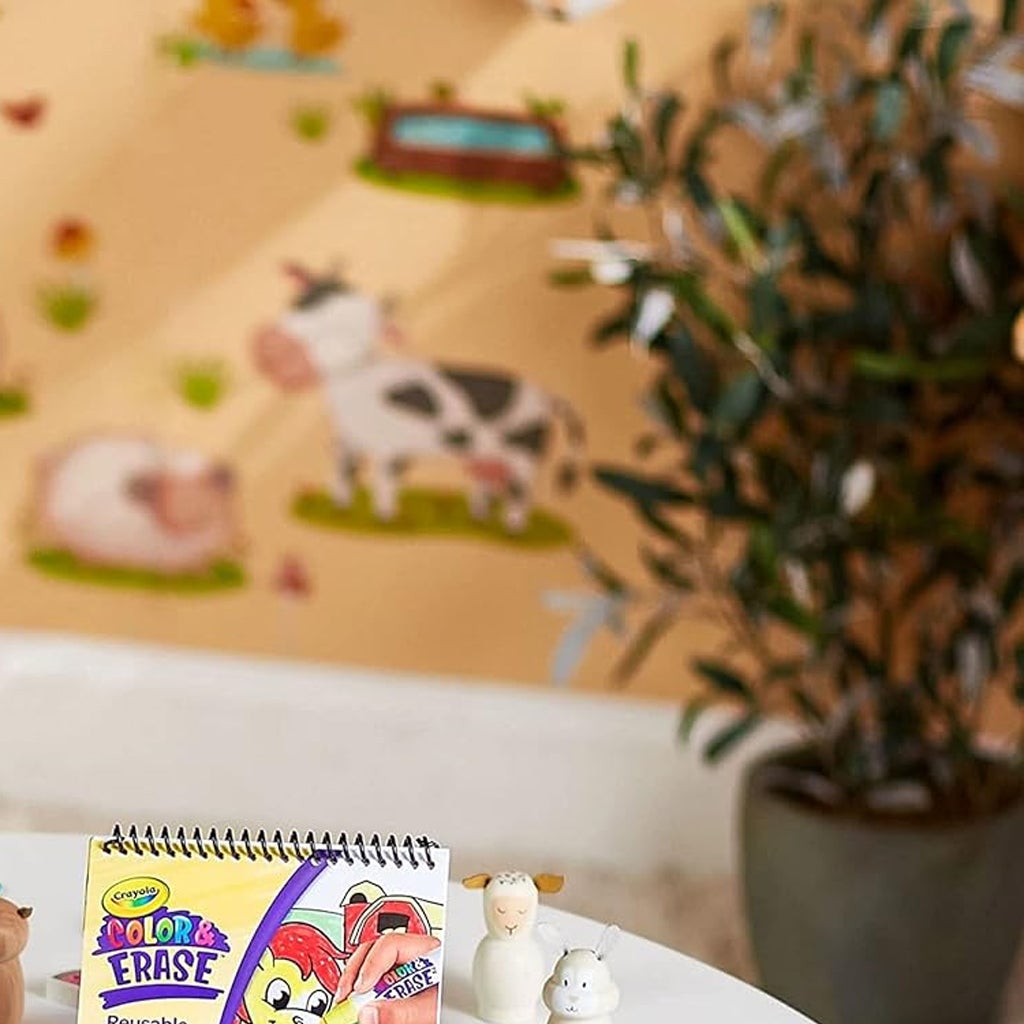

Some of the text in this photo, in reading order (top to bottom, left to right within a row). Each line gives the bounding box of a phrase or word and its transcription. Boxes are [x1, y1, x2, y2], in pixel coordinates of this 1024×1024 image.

[113, 886, 157, 901] Crayola
[107, 915, 193, 948] COLOR
[107, 949, 218, 985] ERASE
[383, 969, 433, 999] ERASE
